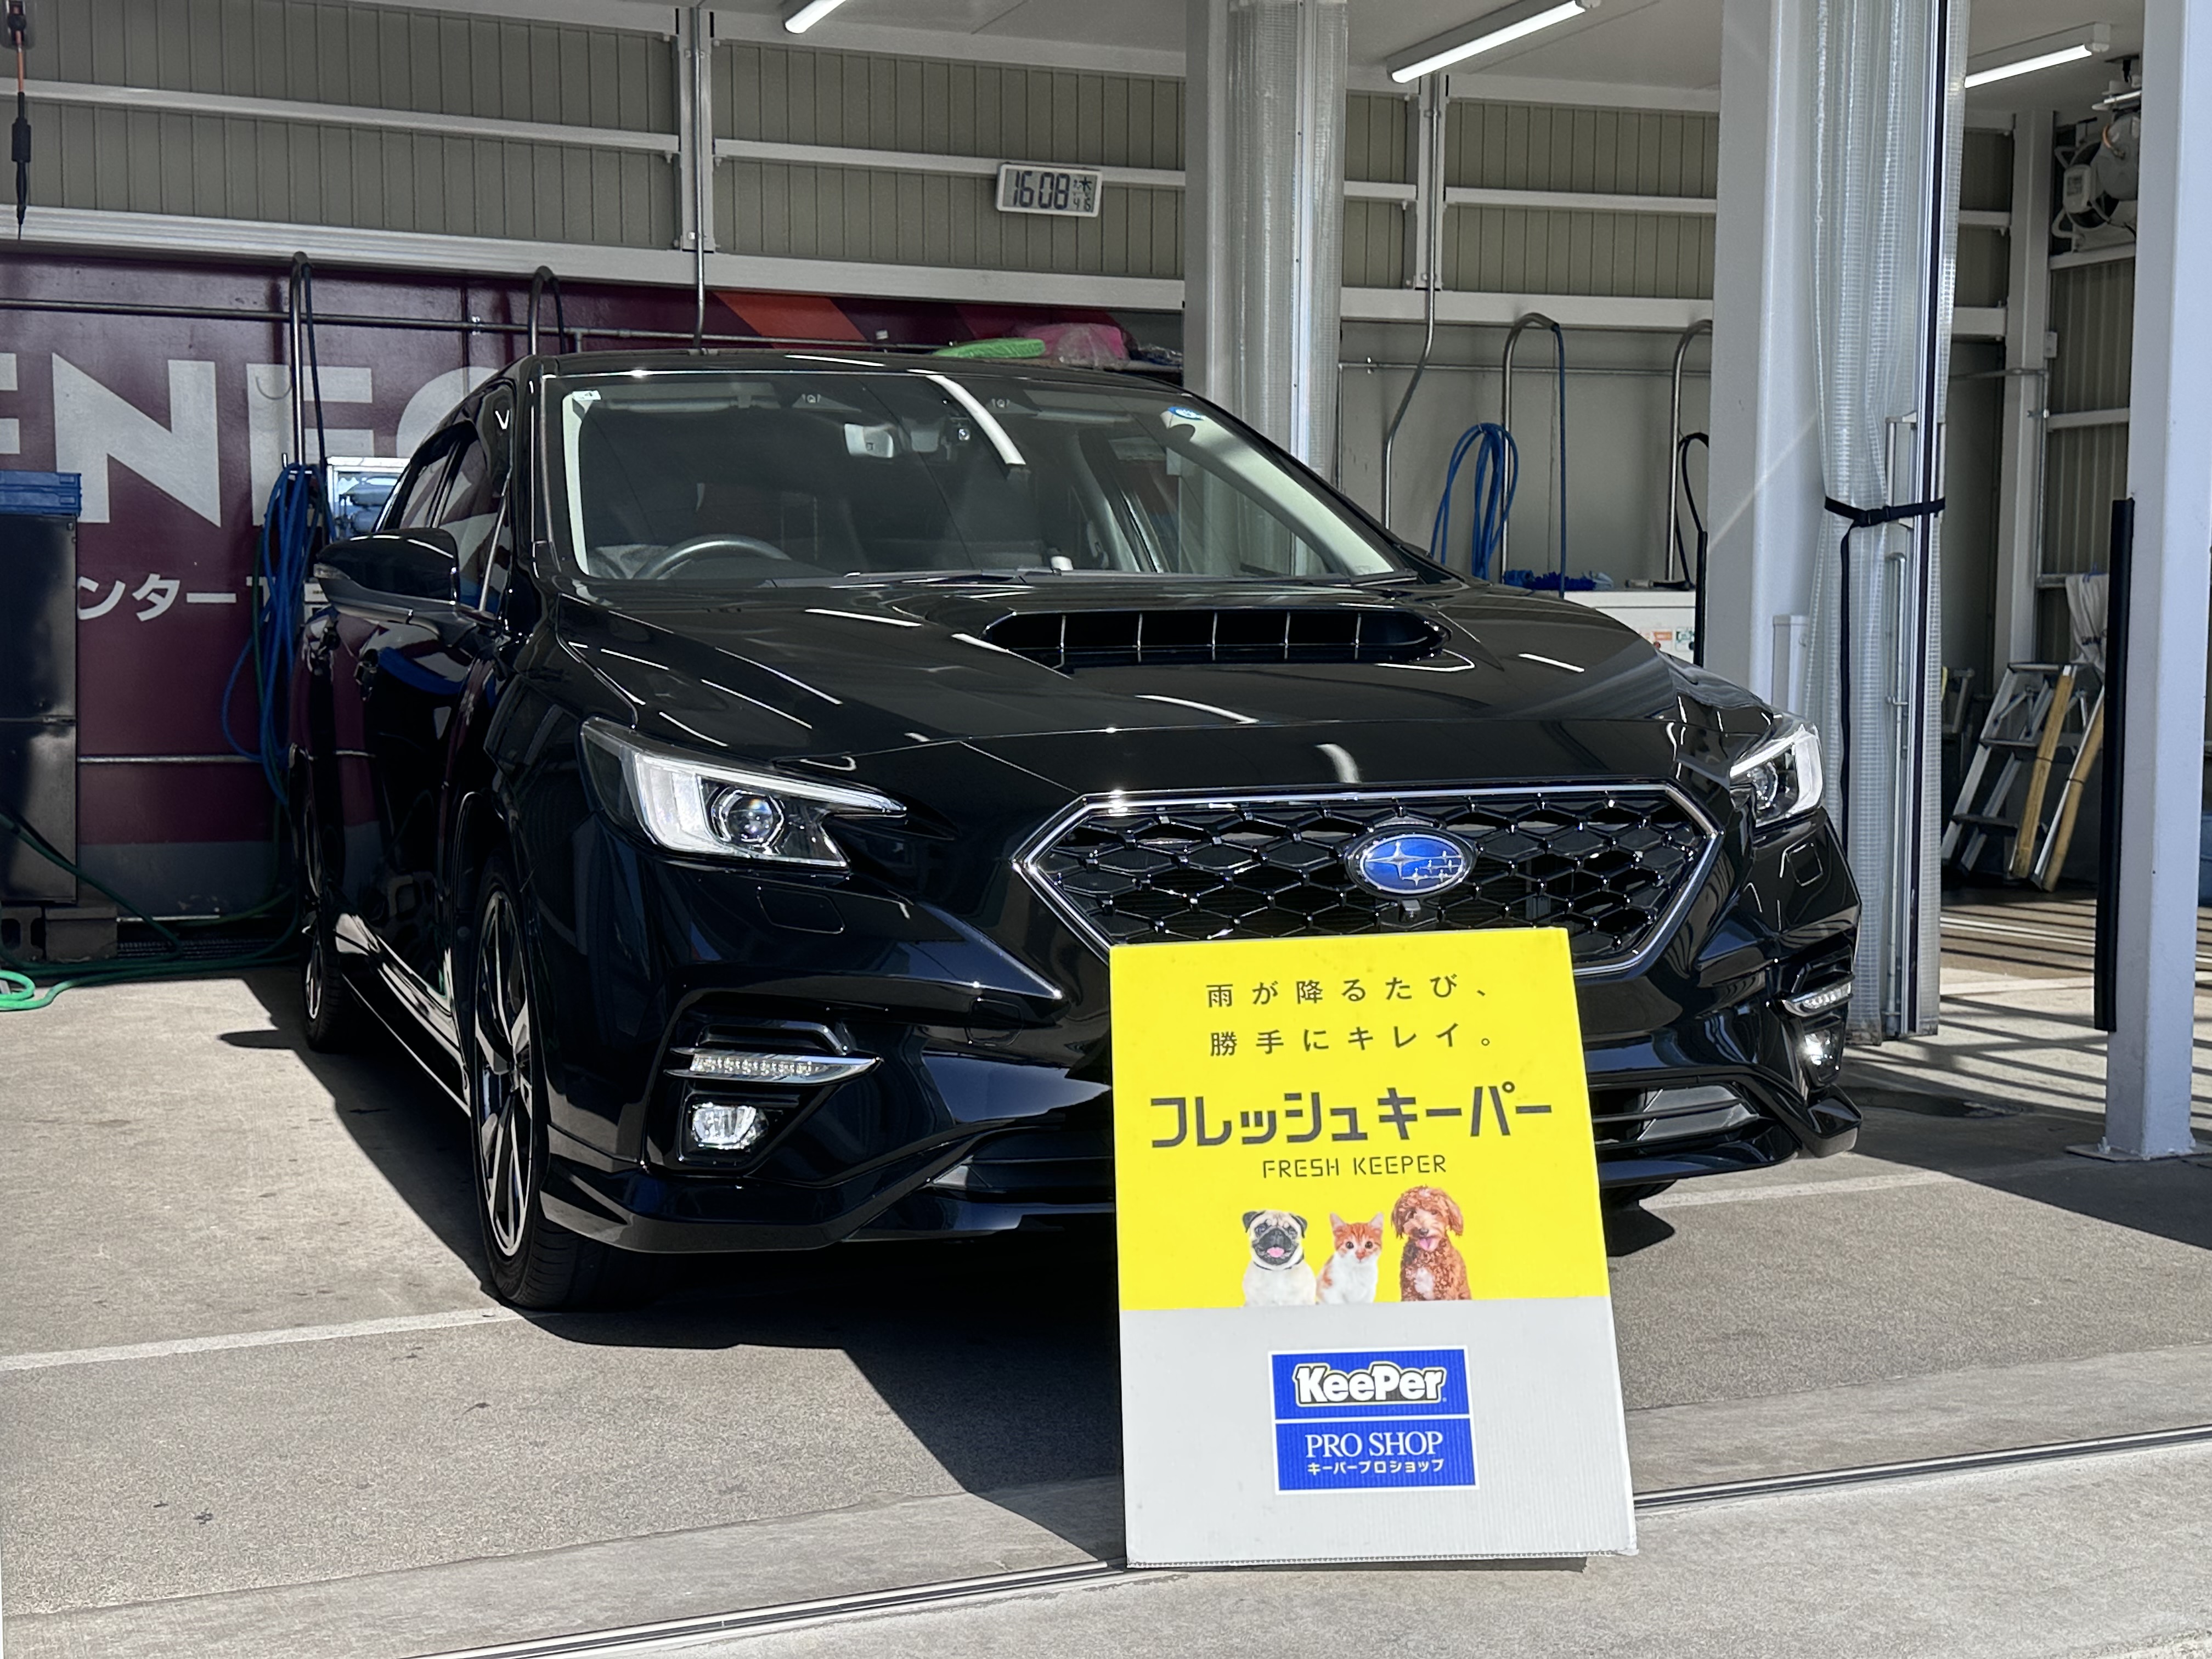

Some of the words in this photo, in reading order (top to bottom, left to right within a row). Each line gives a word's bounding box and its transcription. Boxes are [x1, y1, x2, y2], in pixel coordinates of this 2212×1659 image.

[0, 353, 501, 528] NE
[1206, 974, 1486, 1008] 雨が降るたび、
[1210, 1023, 1491, 1057] 勝手にキレイ。
[1150, 1081, 1552, 1148] フレッシュキーパー
[1262, 1158, 1340, 1178] FRESH
[1353, 1154, 1447, 1176] KEEPER
[1294, 1363, 1446, 1406] KeePer
[1305, 1432, 1363, 1458] PRO
[1368, 1431, 1443, 1457] SHOP
[1307, 1458, 1444, 1475] キーパープロショップ
